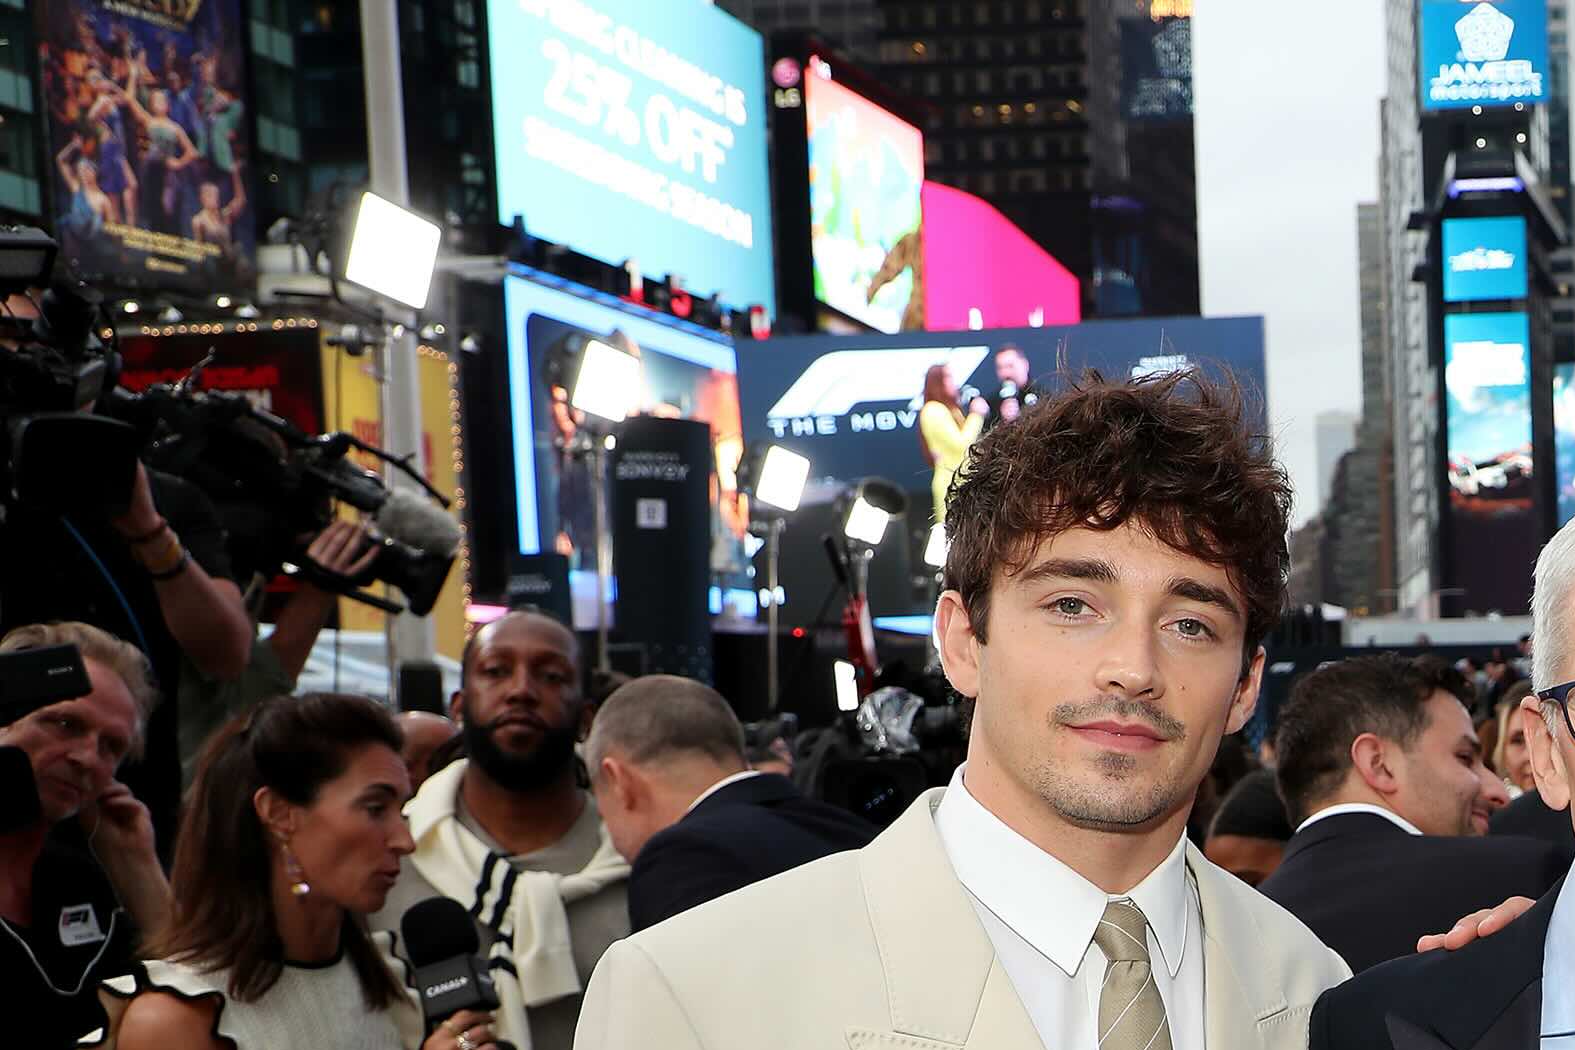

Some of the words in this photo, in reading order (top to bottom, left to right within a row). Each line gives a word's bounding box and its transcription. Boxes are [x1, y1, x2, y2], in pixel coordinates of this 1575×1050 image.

[541, 37, 641, 146] 25%
[645, 93, 735, 183] OFF
[767, 414, 838, 438] THE
[851, 408, 918, 433] MOV
[425, 976, 469, 999] CANAL+
